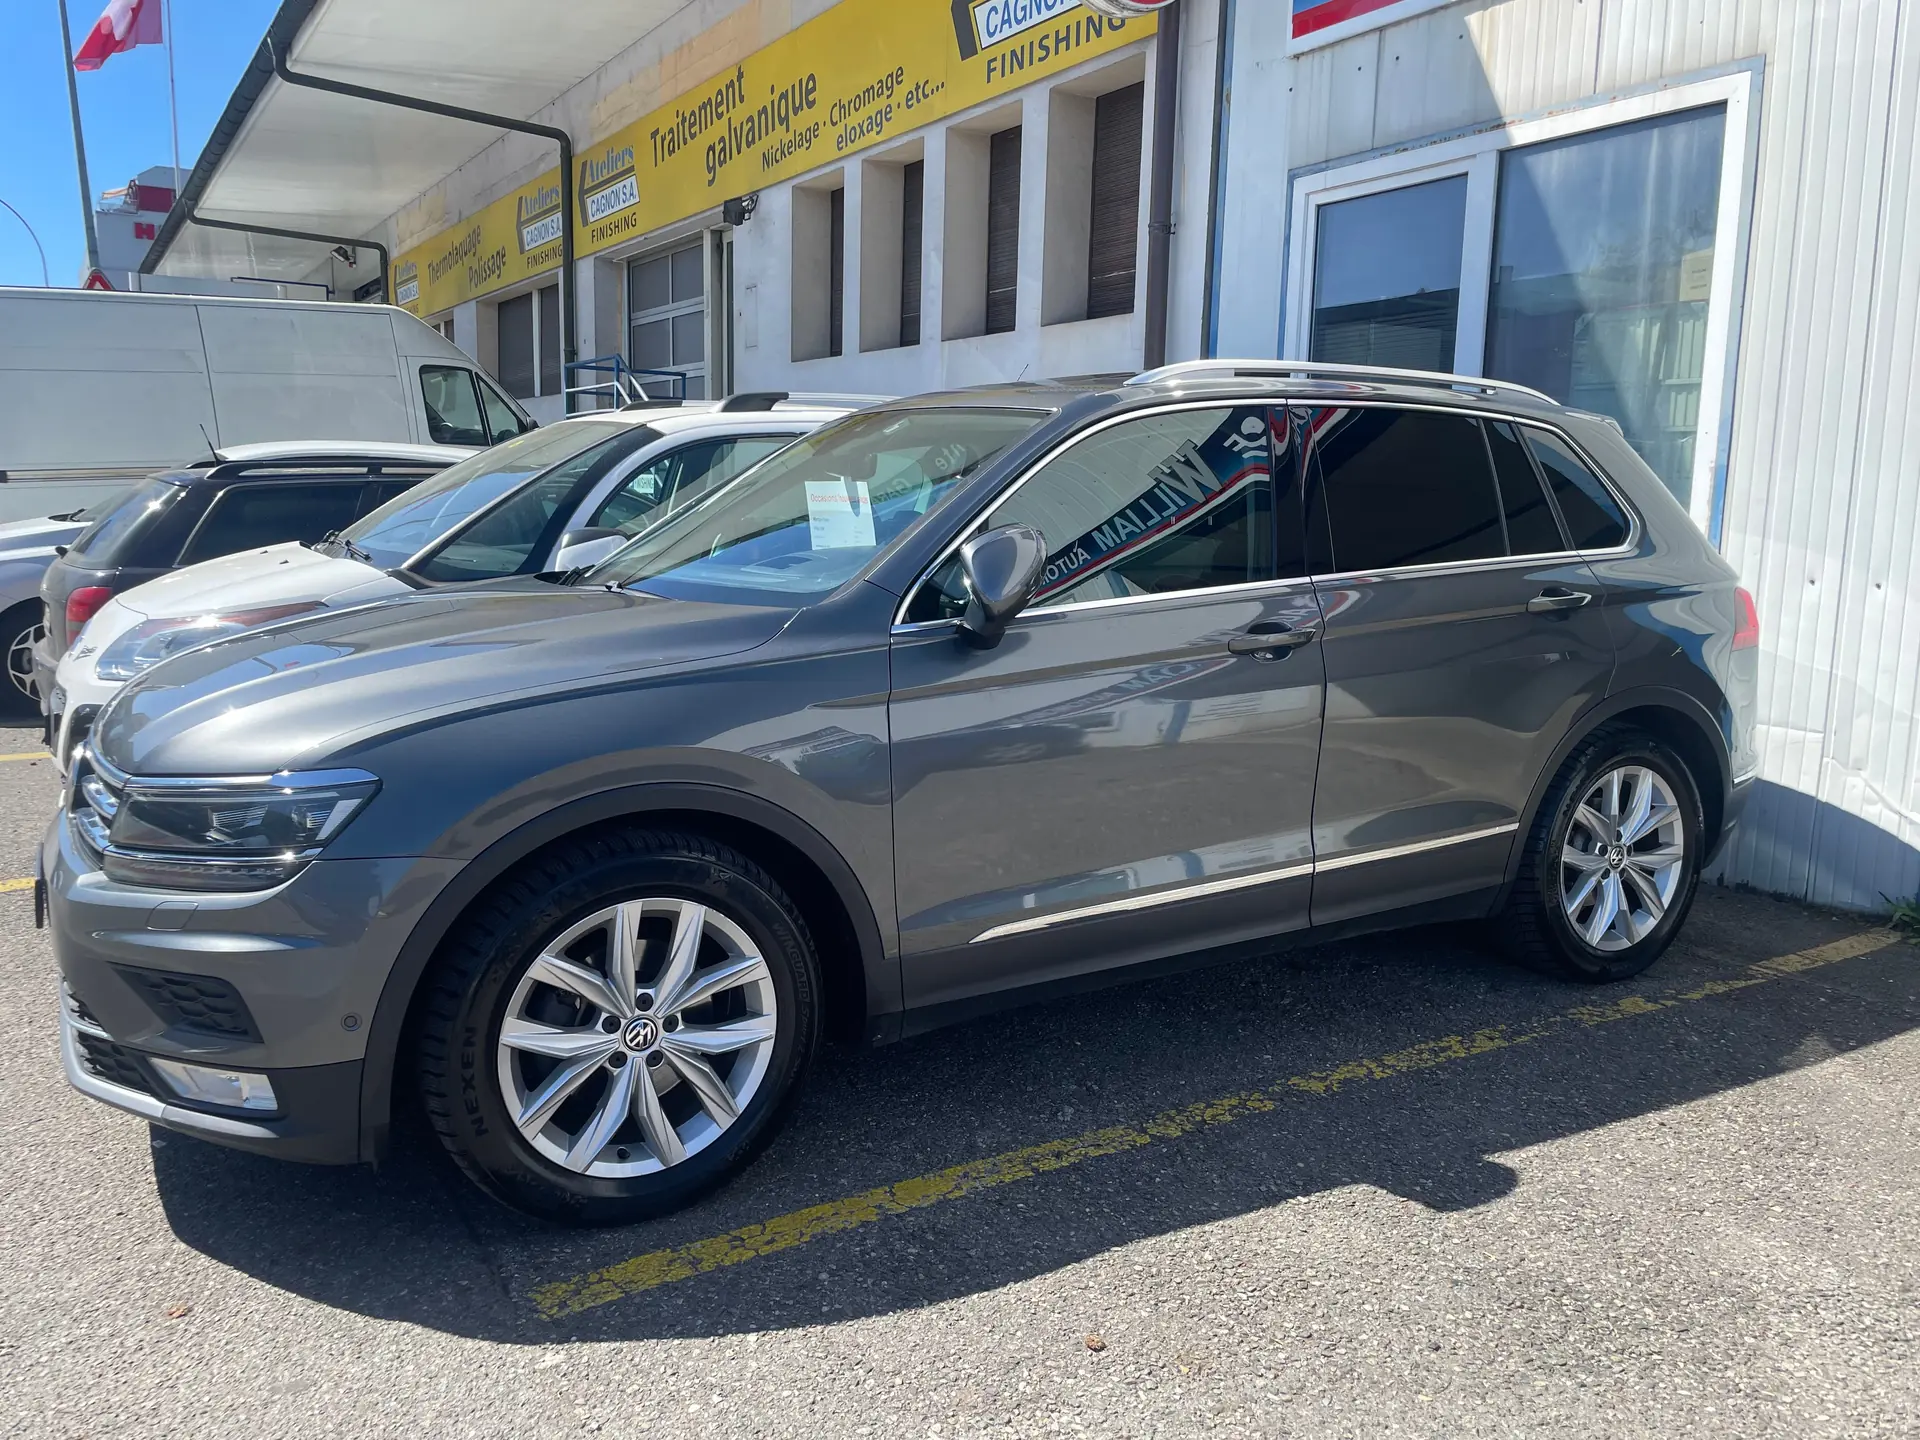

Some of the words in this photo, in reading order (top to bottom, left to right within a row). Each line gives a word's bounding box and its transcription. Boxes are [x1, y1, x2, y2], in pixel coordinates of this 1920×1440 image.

[986, 0, 1066, 39] CAGN
[650, 64, 745, 168] Traitement
[705, 72, 818, 188] galvanique
[762, 121, 820, 173] Nickelage
[829, 65, 904, 127] Chromage
[836, 103, 893, 151] eloxage
[905, 79, 945, 110] etc...
[588, 144, 634, 185] Ateliers
[523, 184, 560, 216] Ateliers
[590, 187, 621, 218] CAGNON
[621, 181, 637, 204] S.A.
[525, 222, 550, 248] CAGNON
[591, 212, 637, 244] FINISHING
[427, 224, 481, 287] Thermolaquage
[468, 245, 507, 292] Polissage
[526, 243, 563, 270] FINISHING
[771, 921, 810, 1003] WINGUARD
[460, 1025, 490, 1137] NEXEN
